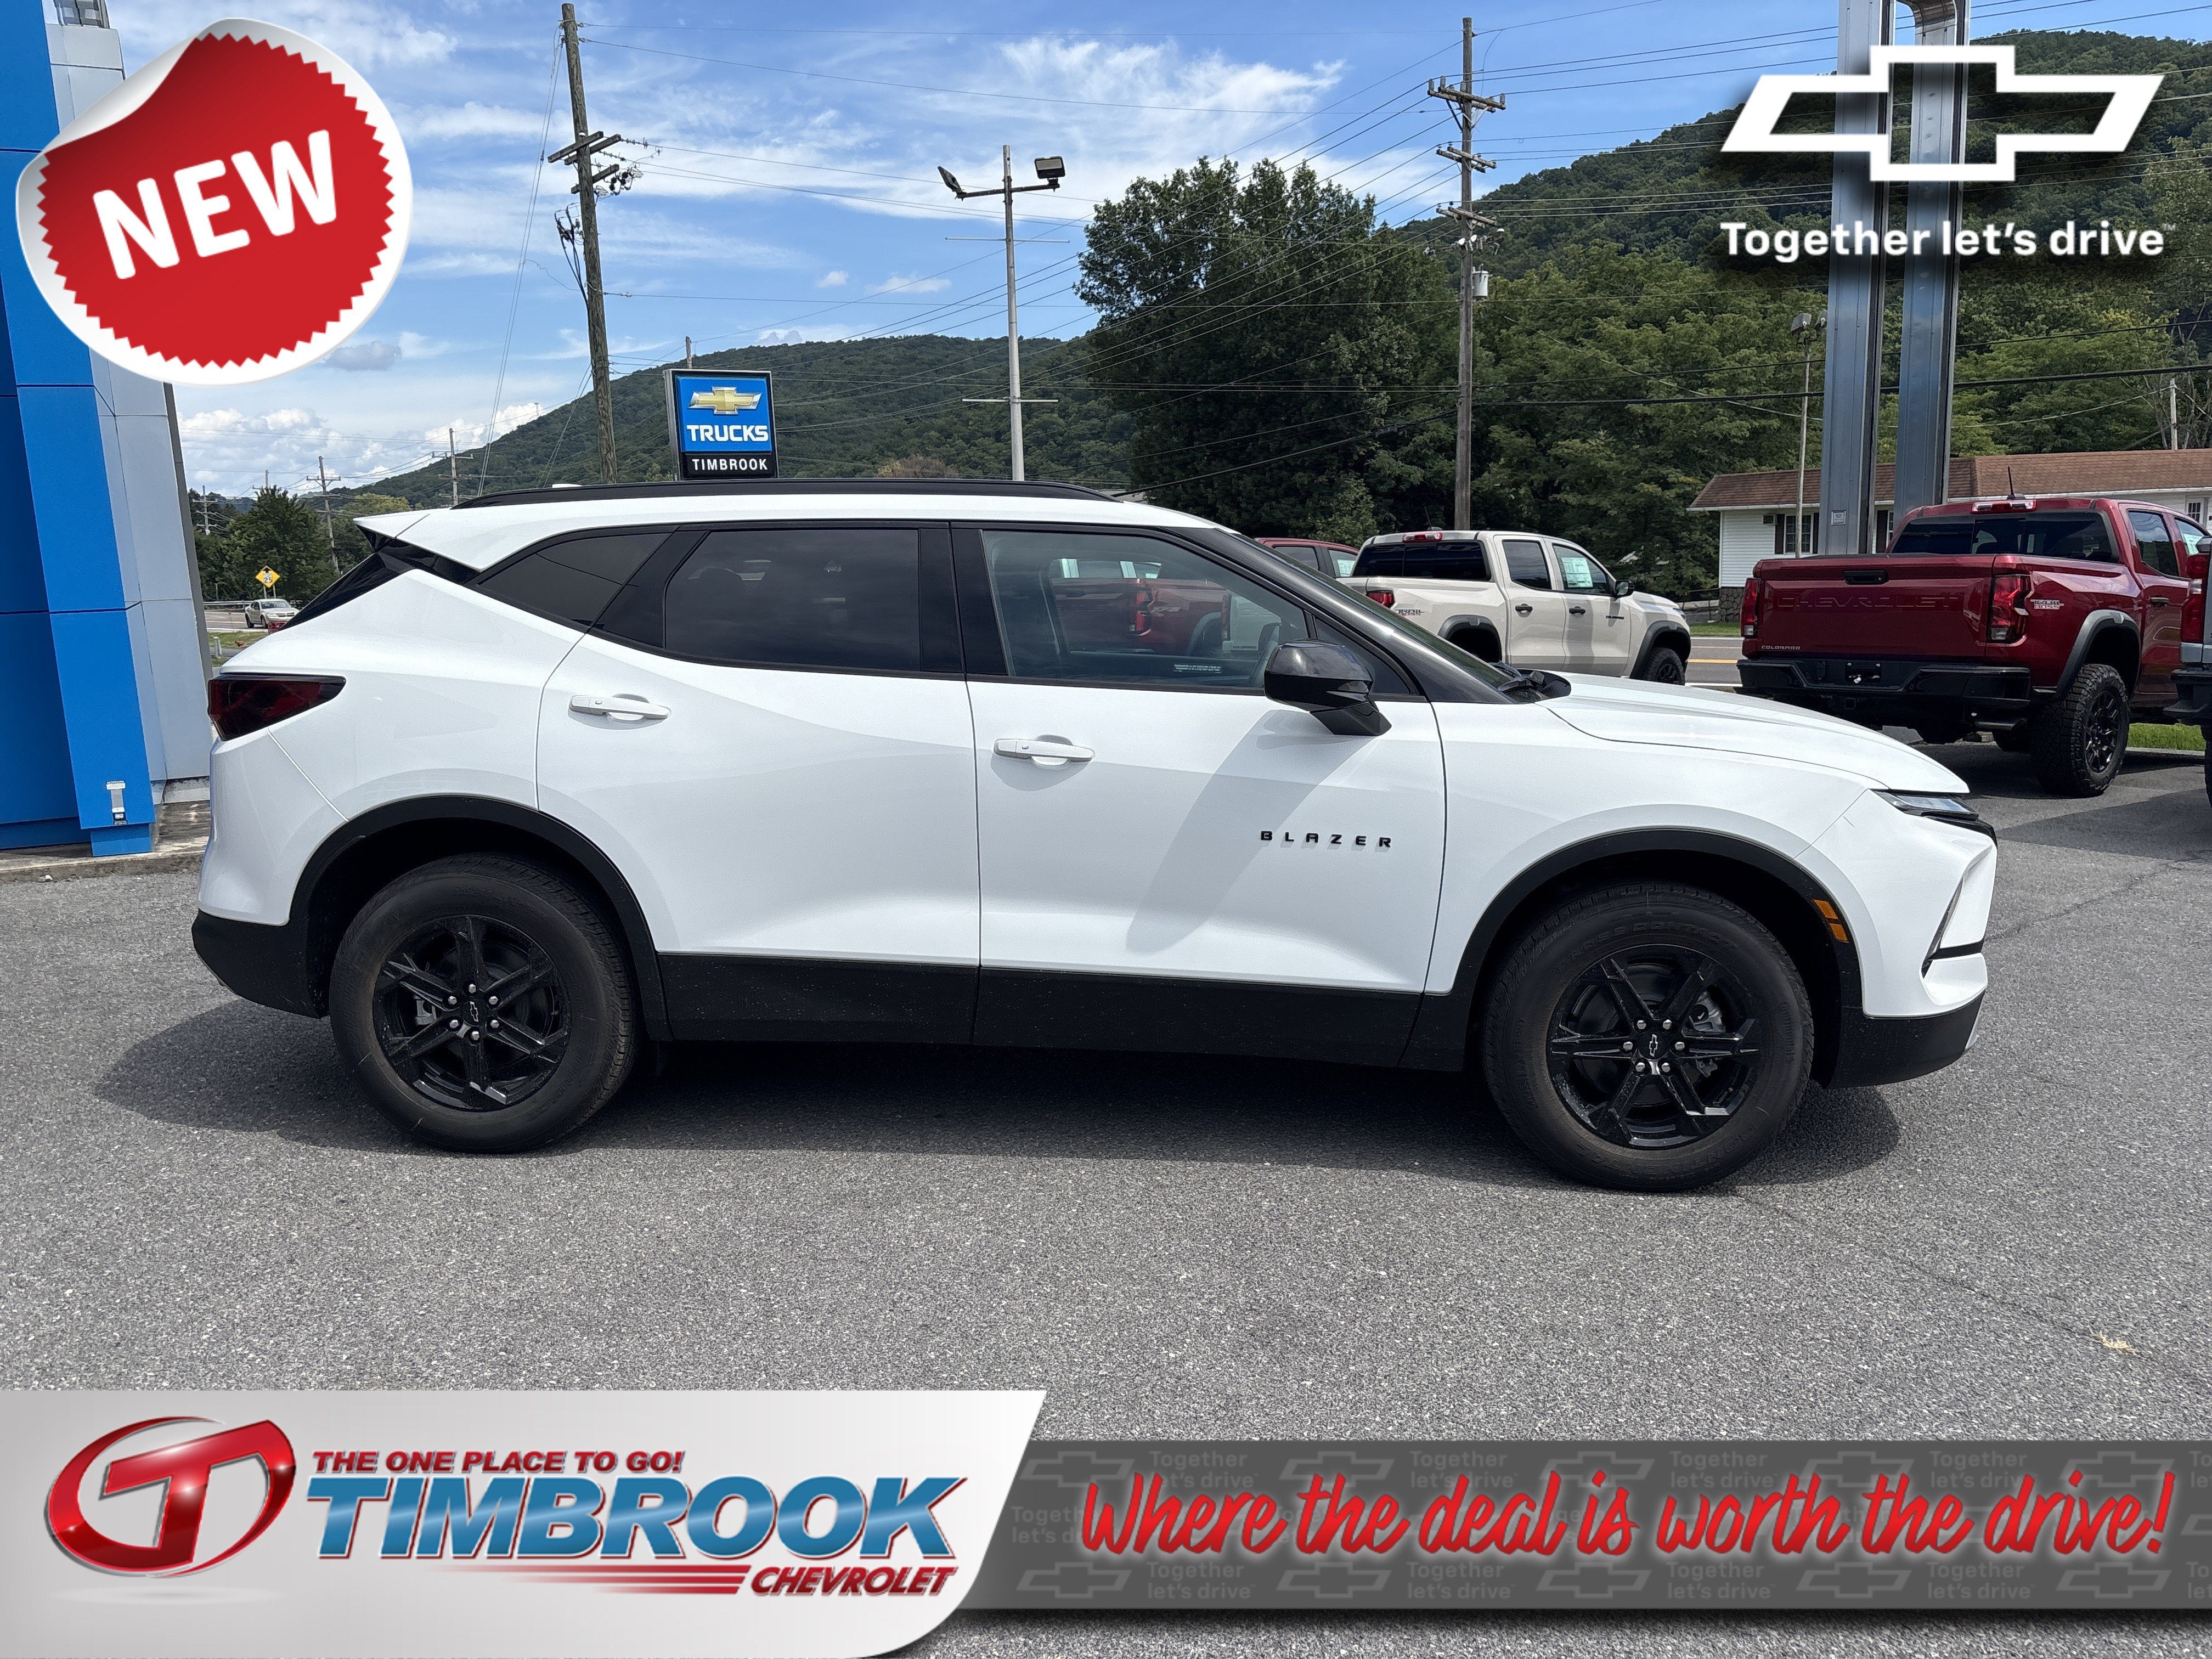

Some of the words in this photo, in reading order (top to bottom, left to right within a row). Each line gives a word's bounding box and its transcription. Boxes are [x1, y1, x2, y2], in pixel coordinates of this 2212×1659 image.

[686, 425, 769, 442] TRUCKS
[692, 458, 768, 471] TIMBROOK
[1260, 831, 1391, 848] BLAZER
